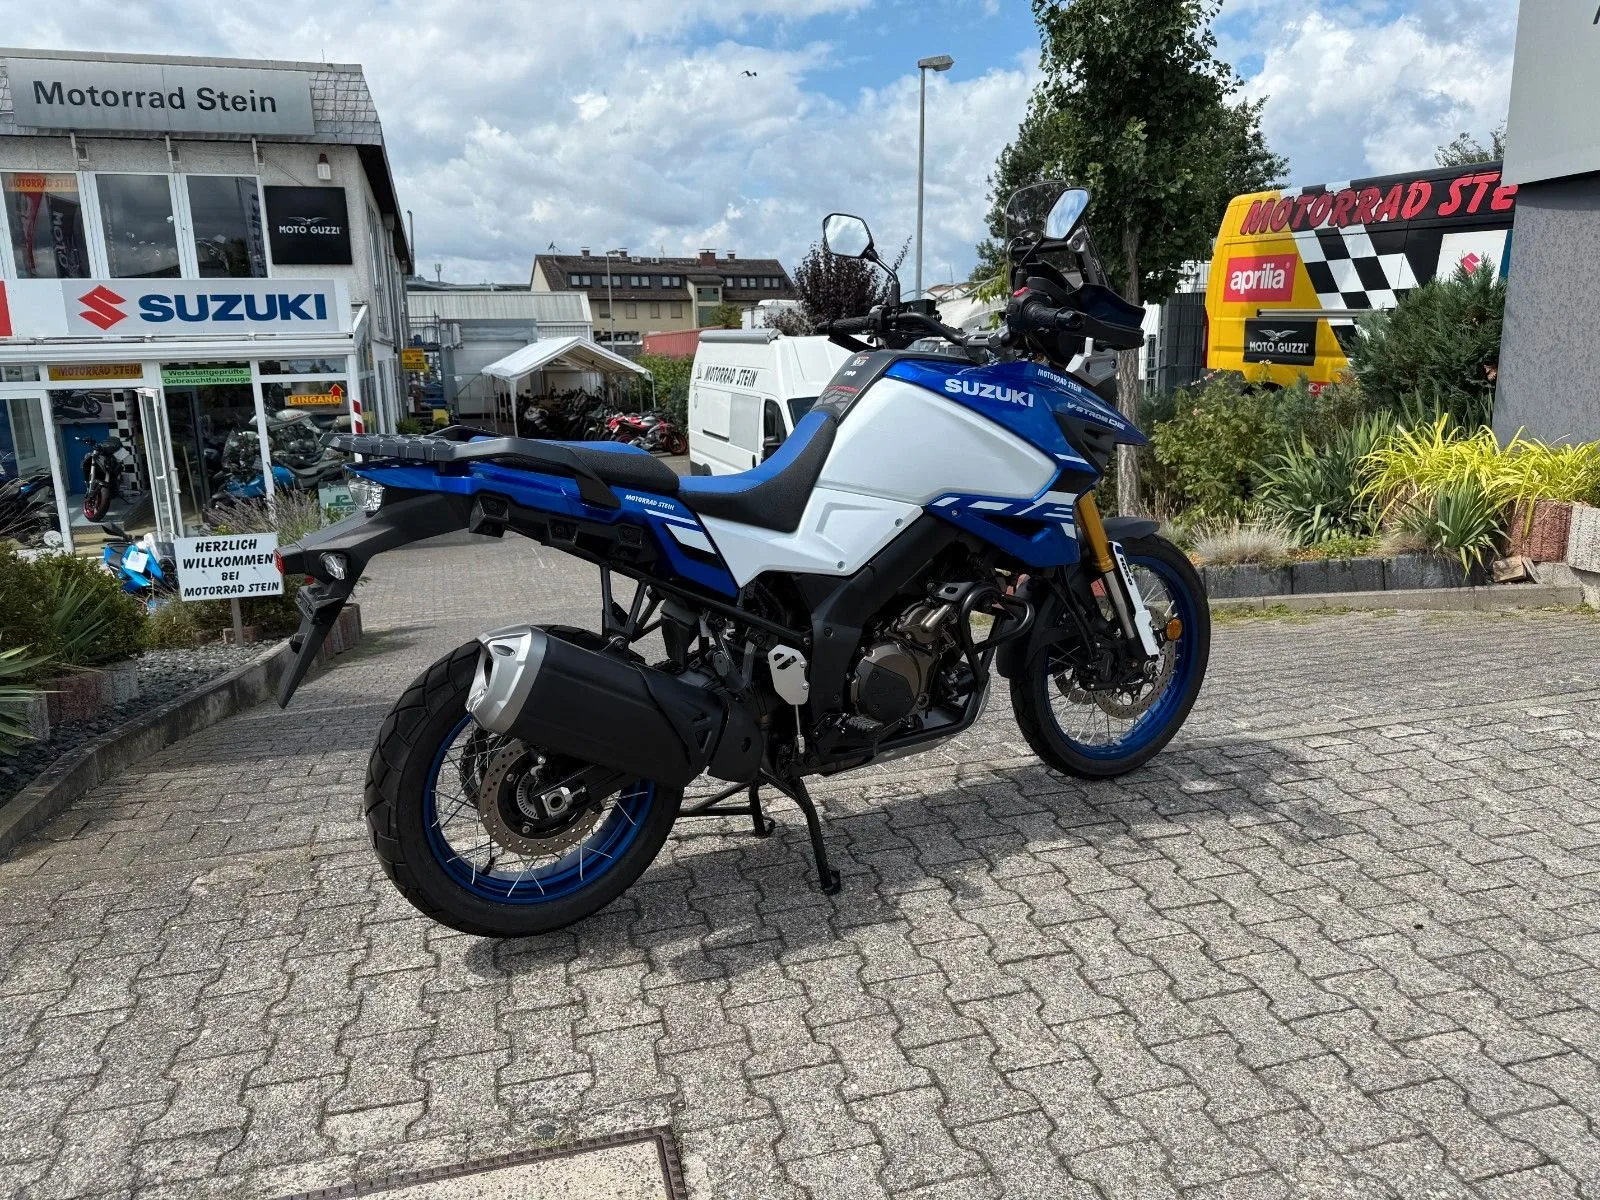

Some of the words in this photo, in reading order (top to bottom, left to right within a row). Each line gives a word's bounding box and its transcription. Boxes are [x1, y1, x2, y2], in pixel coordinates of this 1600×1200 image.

[33, 80, 186, 110] Motorrad
[196, 87, 277, 112] Stein
[1240, 181, 1432, 235] MOTORRAD
[279, 226, 307, 234] MOTO
[310, 226, 340, 234] GUZZI
[1229, 263, 1286, 294] aprilia
[138, 293, 328, 323] SUZUKI
[1249, 341, 1275, 353] MOTO
[1277, 342, 1307, 353] GUZZI
[58, 366, 111, 377] MOTORRAD
[113, 364, 141, 375] STEIN
[168, 369, 244, 377] Werkstattgeprüfte
[704, 366, 736, 384] MOTORRAD
[736, 368, 759, 388] STEIN
[164, 377, 252, 385] Gebrauchtfahrzeuge
[1038, 368, 1068, 387] MOTORRAD
[1067, 380, 1083, 394] STEIN
[945, 378, 1034, 408] SUZUKI
[625, 494, 658, 506] MOTORRAD
[658, 501, 675, 511] STEIN
[195, 539, 257, 553] HERZLICH
[182, 553, 274, 569] WILLKOMMEN
[221, 571, 240, 581] BEI
[184, 584, 245, 597] MOTORRAD
[248, 582, 280, 593] STEIN
